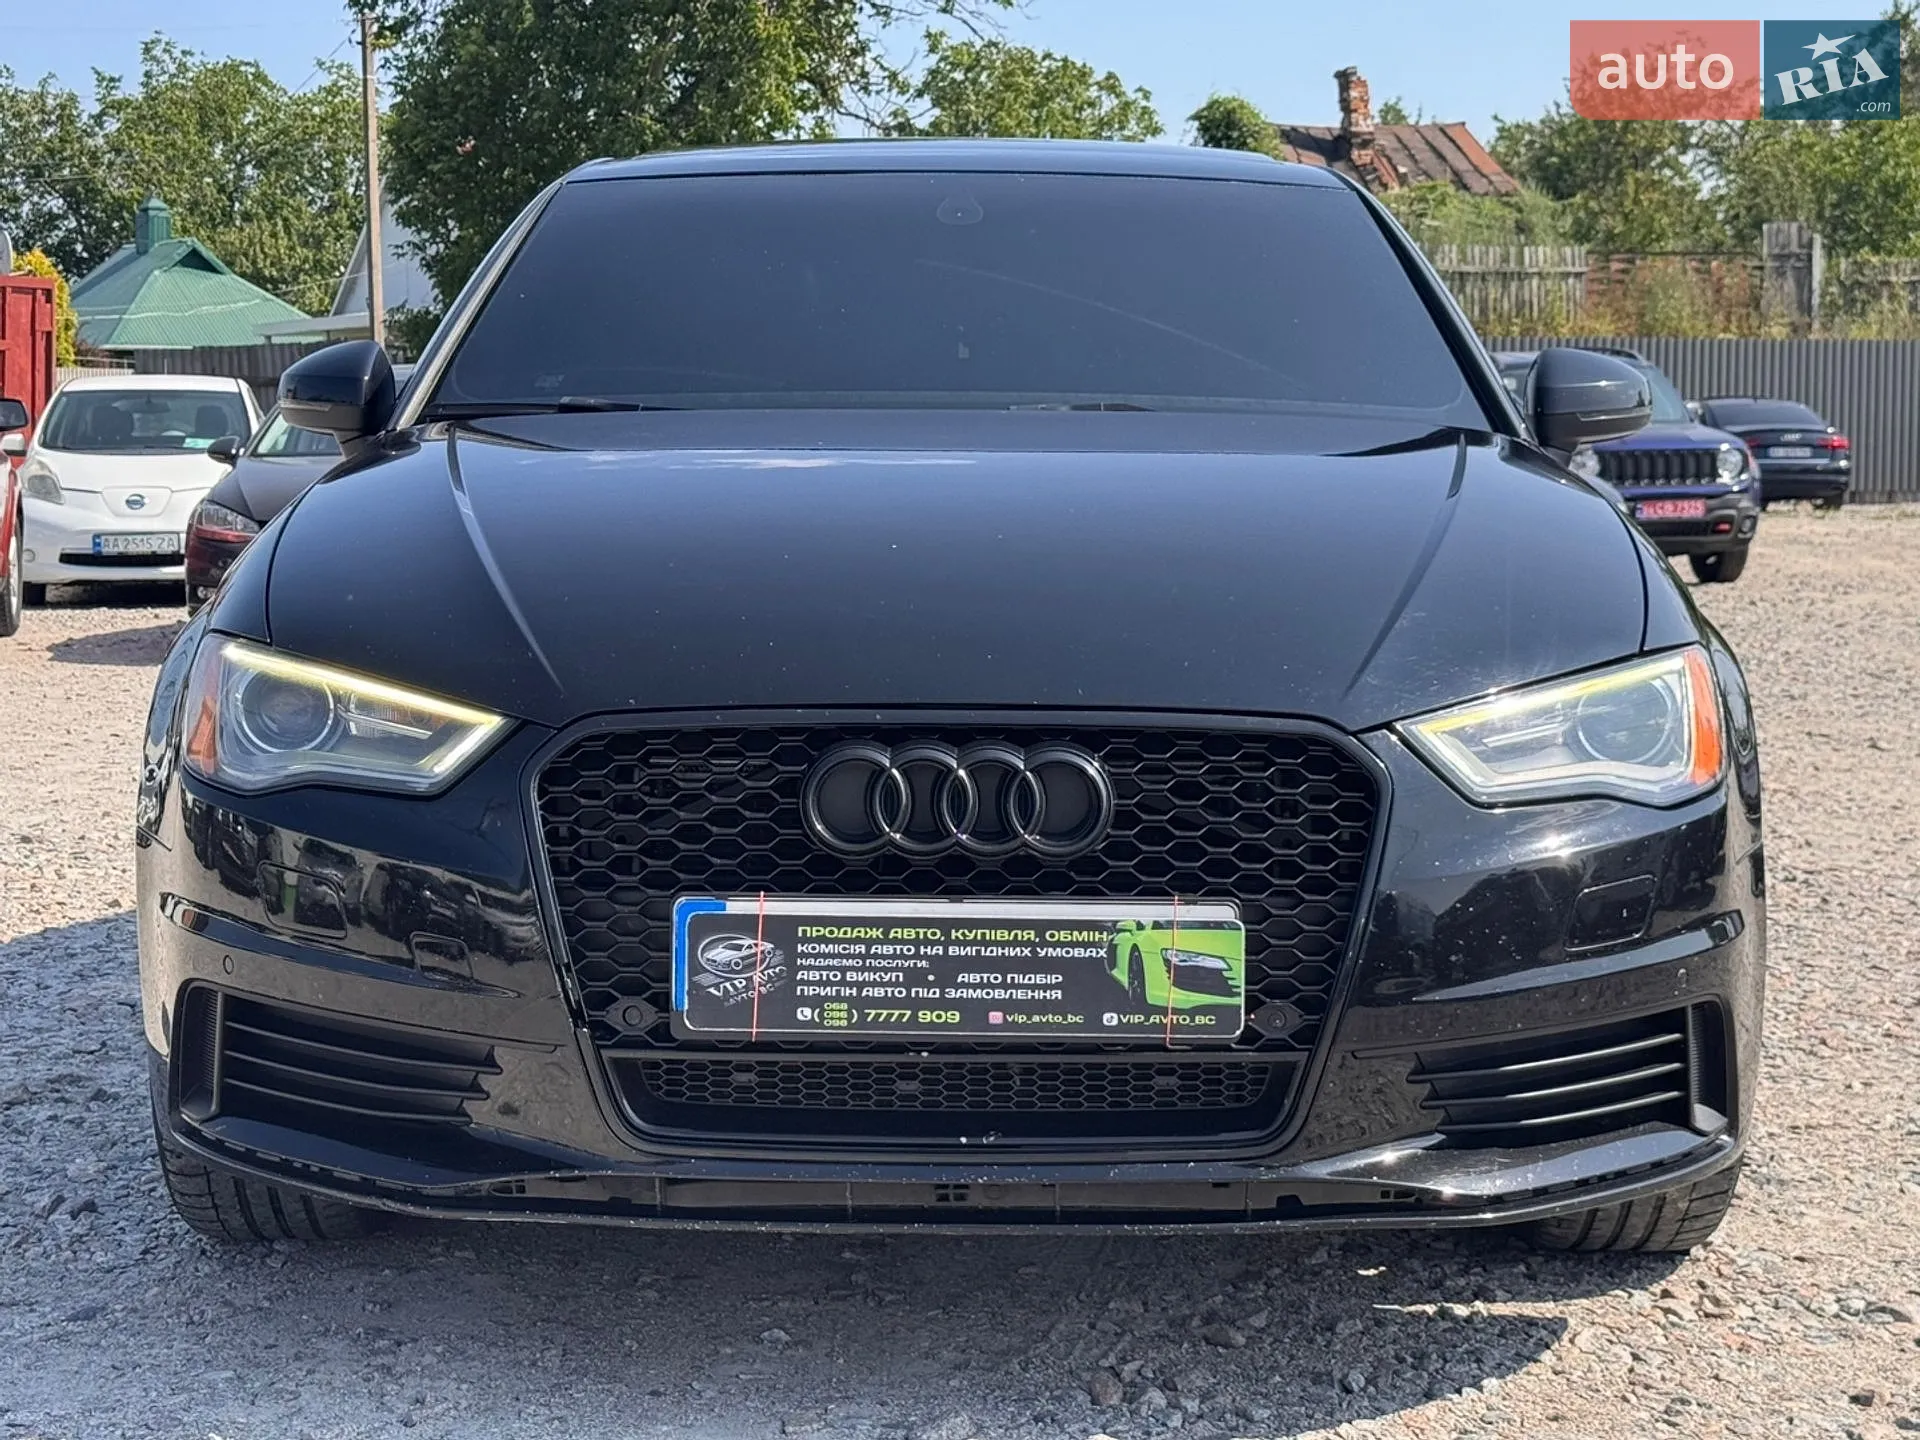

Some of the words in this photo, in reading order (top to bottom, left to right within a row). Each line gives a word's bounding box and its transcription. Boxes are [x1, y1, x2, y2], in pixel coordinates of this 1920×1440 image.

[103, 537, 120, 550] AA
[157, 536, 176, 549] ZA
[797, 926, 884, 939] ПРОДАЖ
[888, 928, 945, 941] АВТО,
[951, 929, 1040, 942] КУПІВЛЯ,
[1045, 930, 1108, 942] ОБМІН
[797, 943, 866, 954] КОМІСІЯ
[870, 945, 915, 955] АВТО
[920, 945, 943, 956] НА
[948, 946, 1032, 957] ВИГІДНИХ
[1036, 947, 1108, 958] УМОВАХ
[796, 957, 863, 967] НАДАЄМО
[866, 958, 930, 968] ПОСЛУГИ:
[796, 970, 842, 981] АВТО
[846, 972, 904, 982] ВИКУП
[957, 973, 1002, 984] АВТО
[1006, 973, 1063, 985] ПІДБІР
[796, 985, 857, 997] ПРИГІН
[861, 987, 907, 998] АВТО
[911, 988, 941, 999] ПІД
[944, 988, 1062, 1000] ЗАМОВЛЕННЯ
[864, 1010, 912, 1022] 7777
[917, 1011, 960, 1023] 909
[1006, 1013, 1084, 1024] vip_avto_bc
[1120, 1014, 1216, 1026] VIP_AVTO_BC
